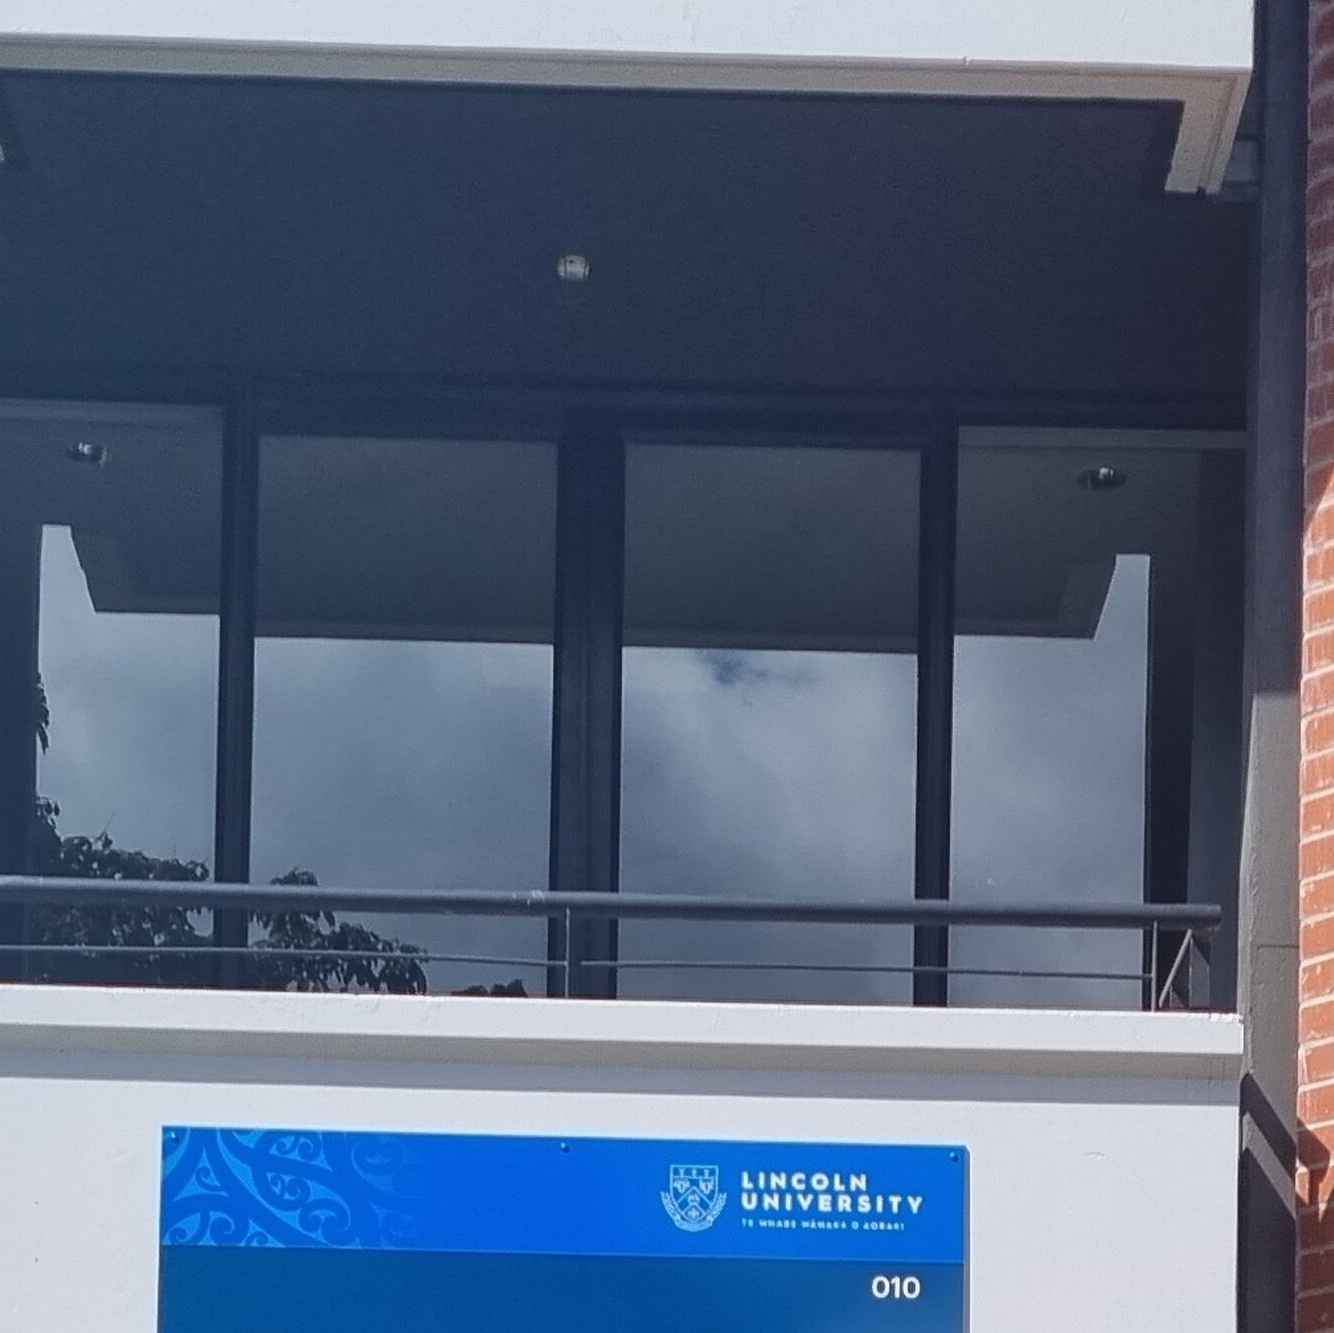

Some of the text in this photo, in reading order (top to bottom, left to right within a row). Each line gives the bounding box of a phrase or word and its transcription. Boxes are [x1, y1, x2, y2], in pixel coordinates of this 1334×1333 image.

[741, 1171, 868, 1193] LINCOLN
[741, 1191, 924, 1215] UNIVERSITY
[871, 1275, 922, 1300] 010
